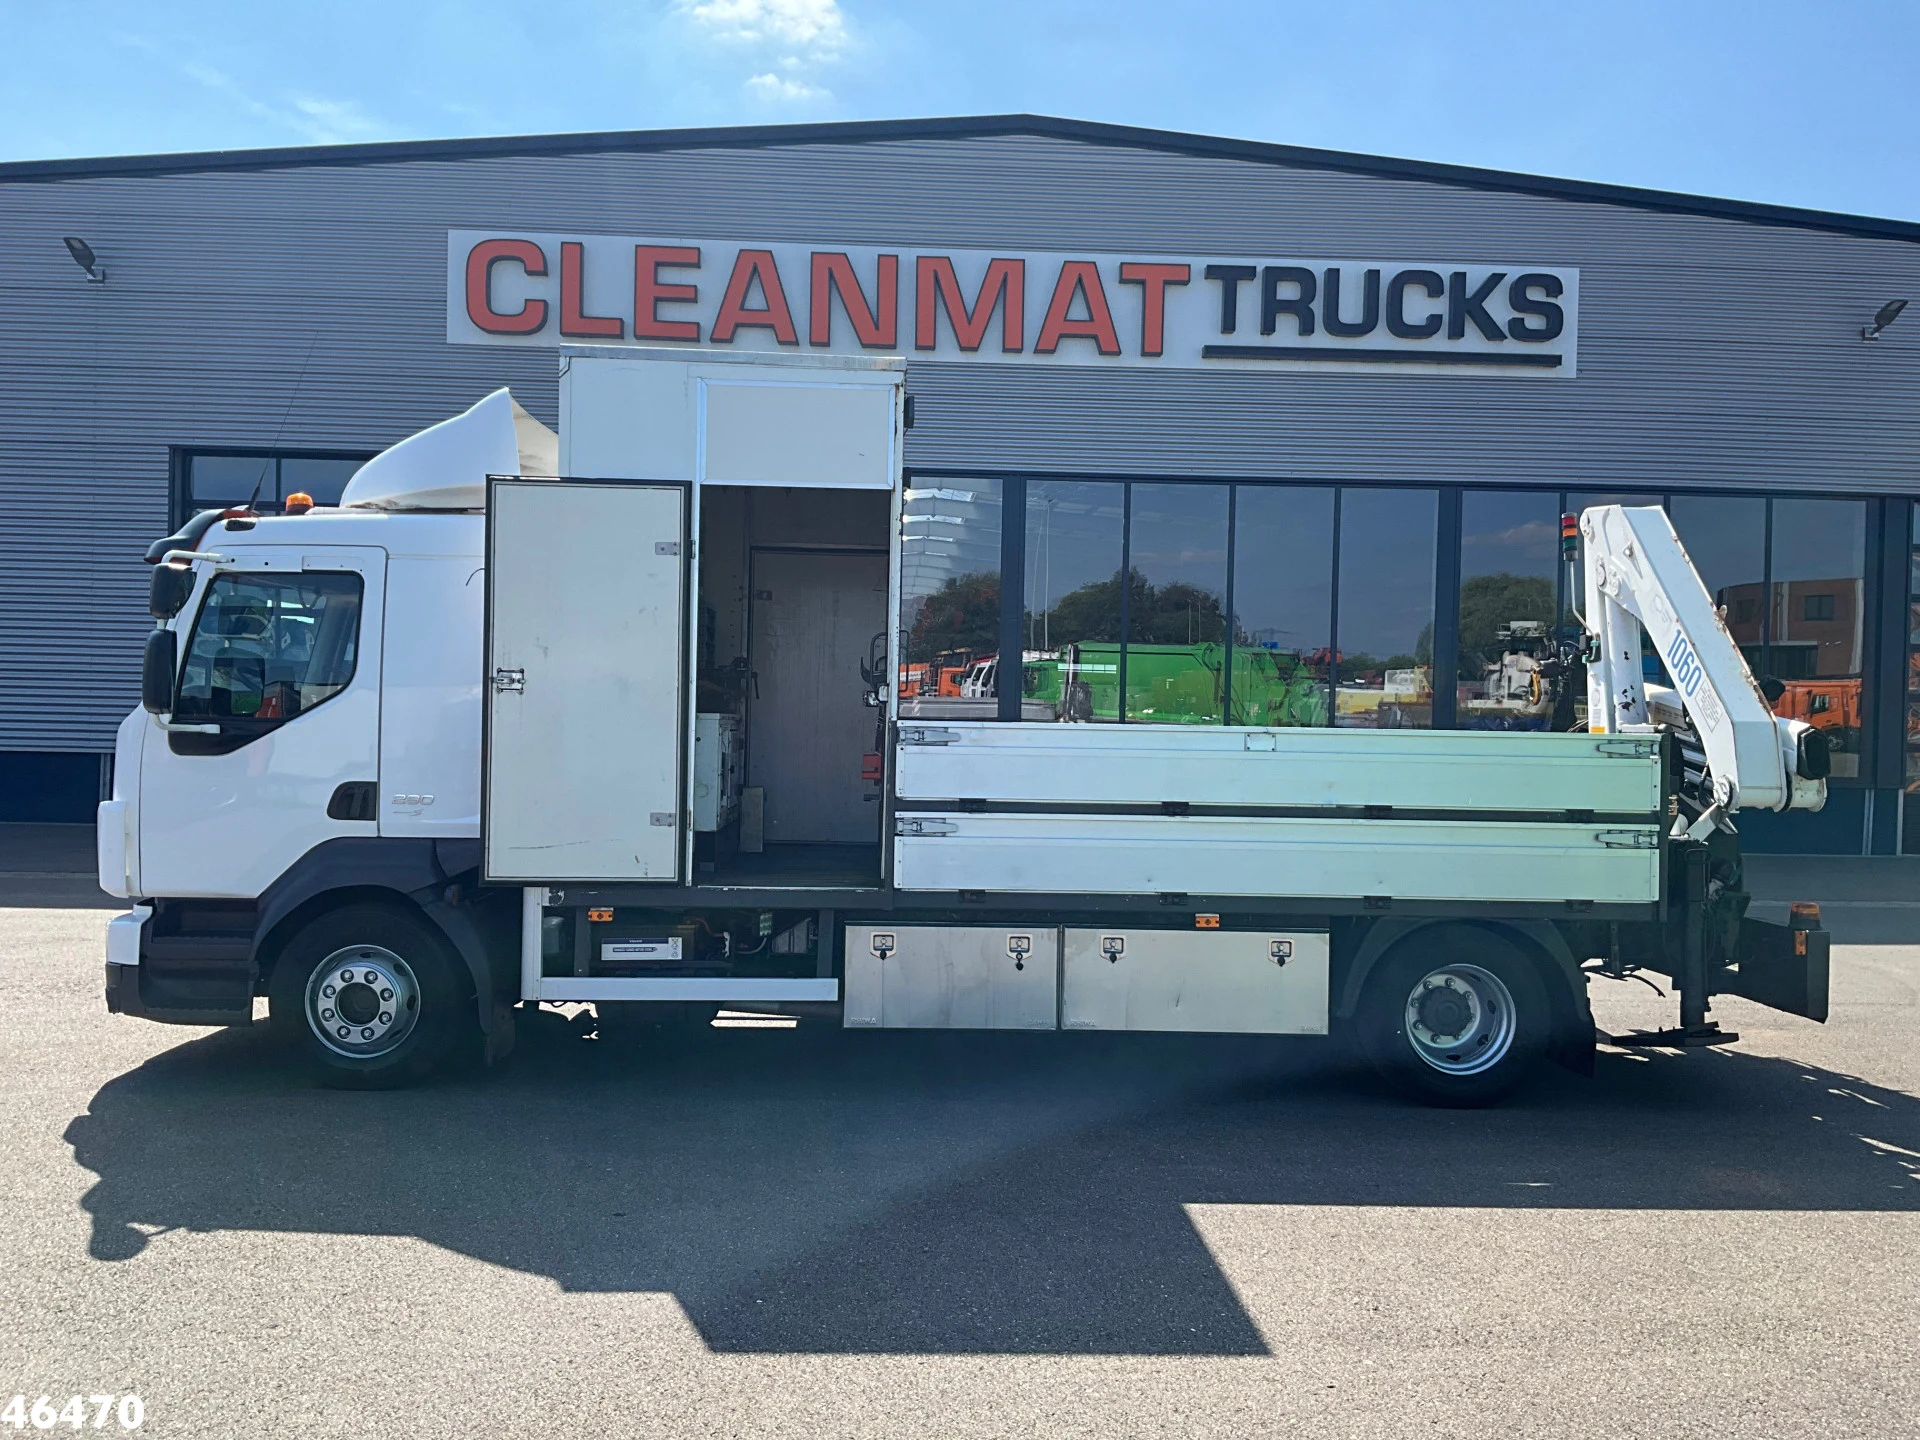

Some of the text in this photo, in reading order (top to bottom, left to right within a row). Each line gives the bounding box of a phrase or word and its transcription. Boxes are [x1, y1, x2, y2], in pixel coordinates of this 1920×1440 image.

[465, 238, 1564, 357] CLEANMAT TRUCKS
[1667, 628, 1702, 698] 1060
